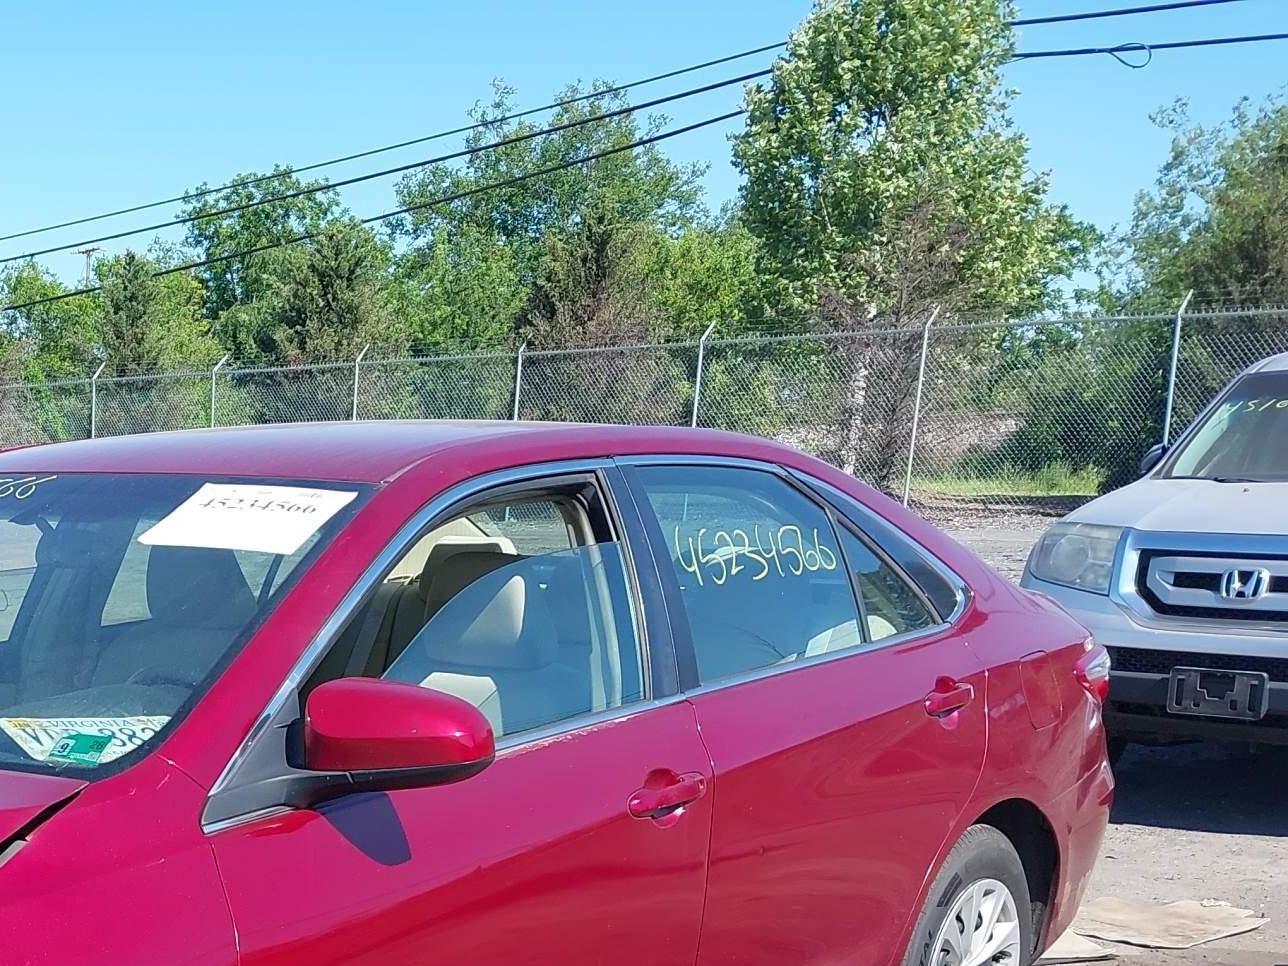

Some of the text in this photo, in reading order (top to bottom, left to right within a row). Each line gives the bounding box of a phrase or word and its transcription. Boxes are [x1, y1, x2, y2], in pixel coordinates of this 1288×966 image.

[674, 525, 837, 586] 45234566
[48, 719, 136, 729] VIRGINIA
[57, 742, 70, 753] 9
